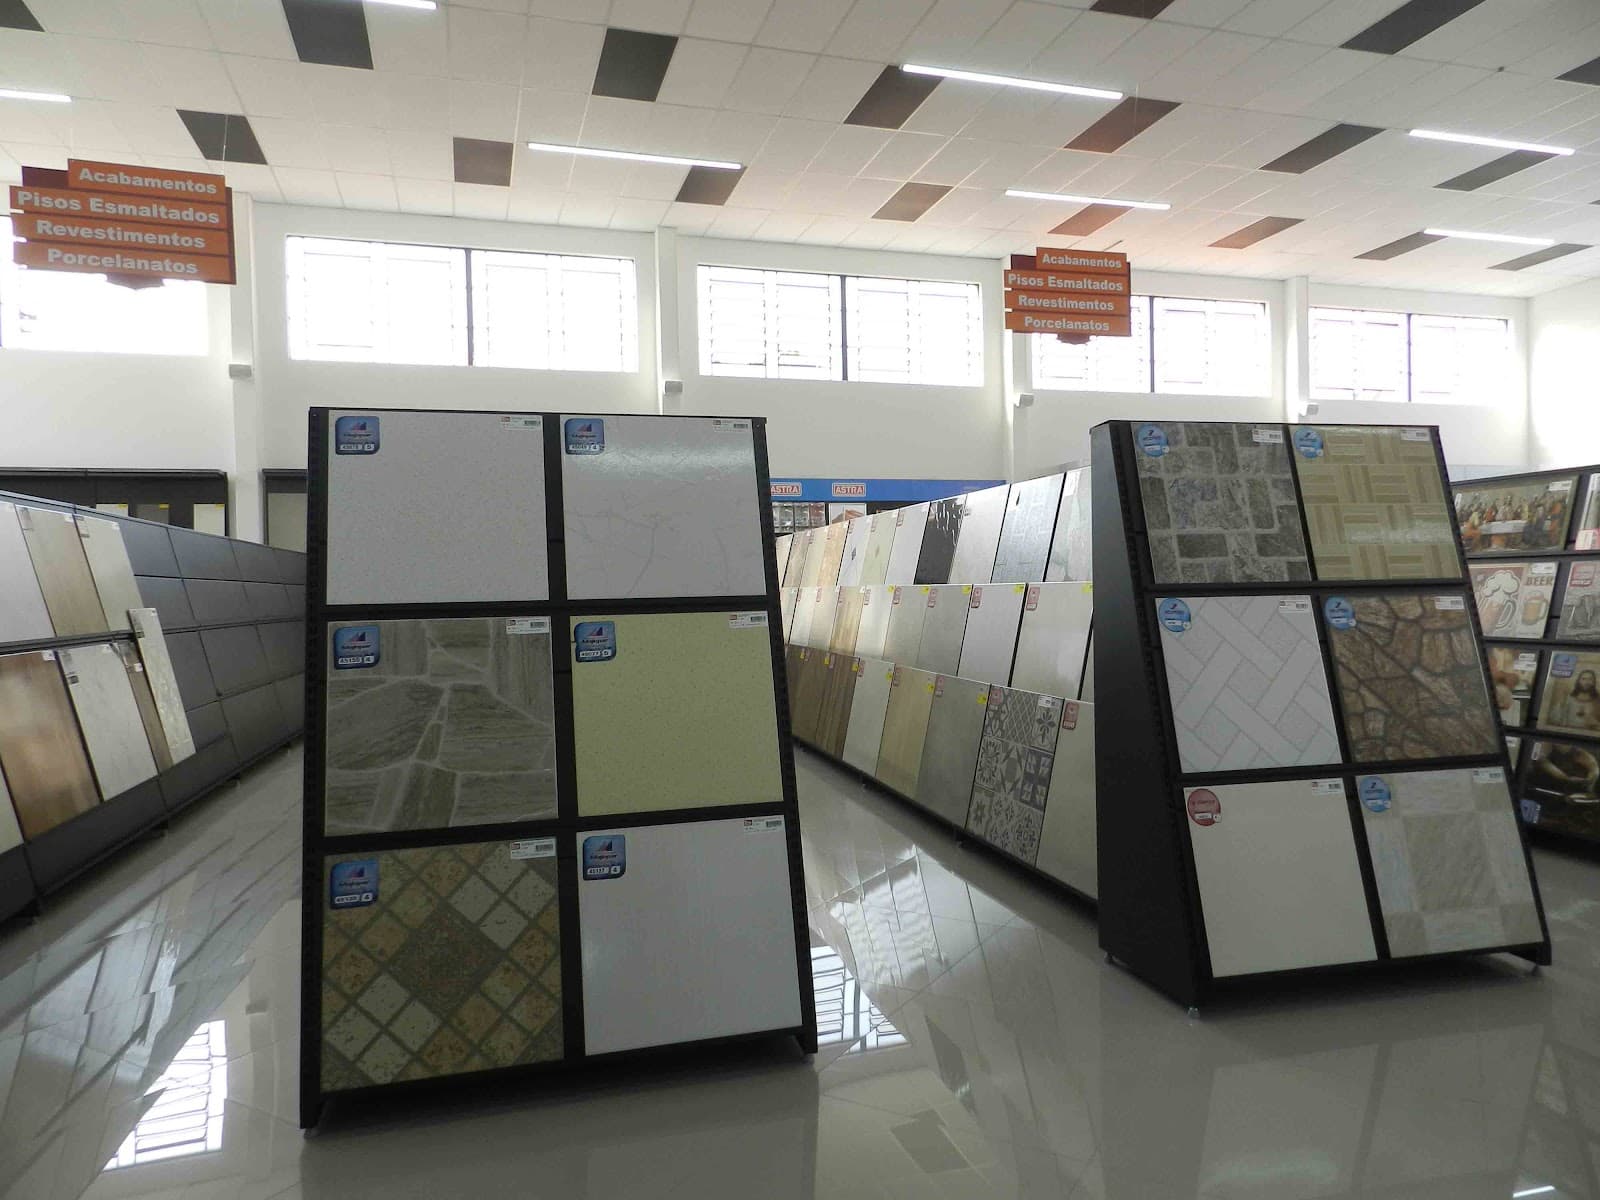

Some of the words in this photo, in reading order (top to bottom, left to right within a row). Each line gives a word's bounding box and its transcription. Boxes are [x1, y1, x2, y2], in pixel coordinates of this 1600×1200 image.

[79, 167, 217, 194] Acabamentos
[17, 190, 81, 211] Pisos
[89, 198, 220, 224] Esmaltados
[36, 219, 206, 249] Revestimentos
[47, 248, 199, 274] Porcelanatos
[1042, 253, 1122, 269] Acabamentos
[1008, 273, 1044, 287] Pisos
[1047, 275, 1123, 291] Esmaltados
[1018, 294, 1114, 311] Revestimentos
[1024, 315, 1110, 332] Porcelanatos
[770, 485, 799, 494] ASTRA
[835, 486, 864, 495] ASTRA
